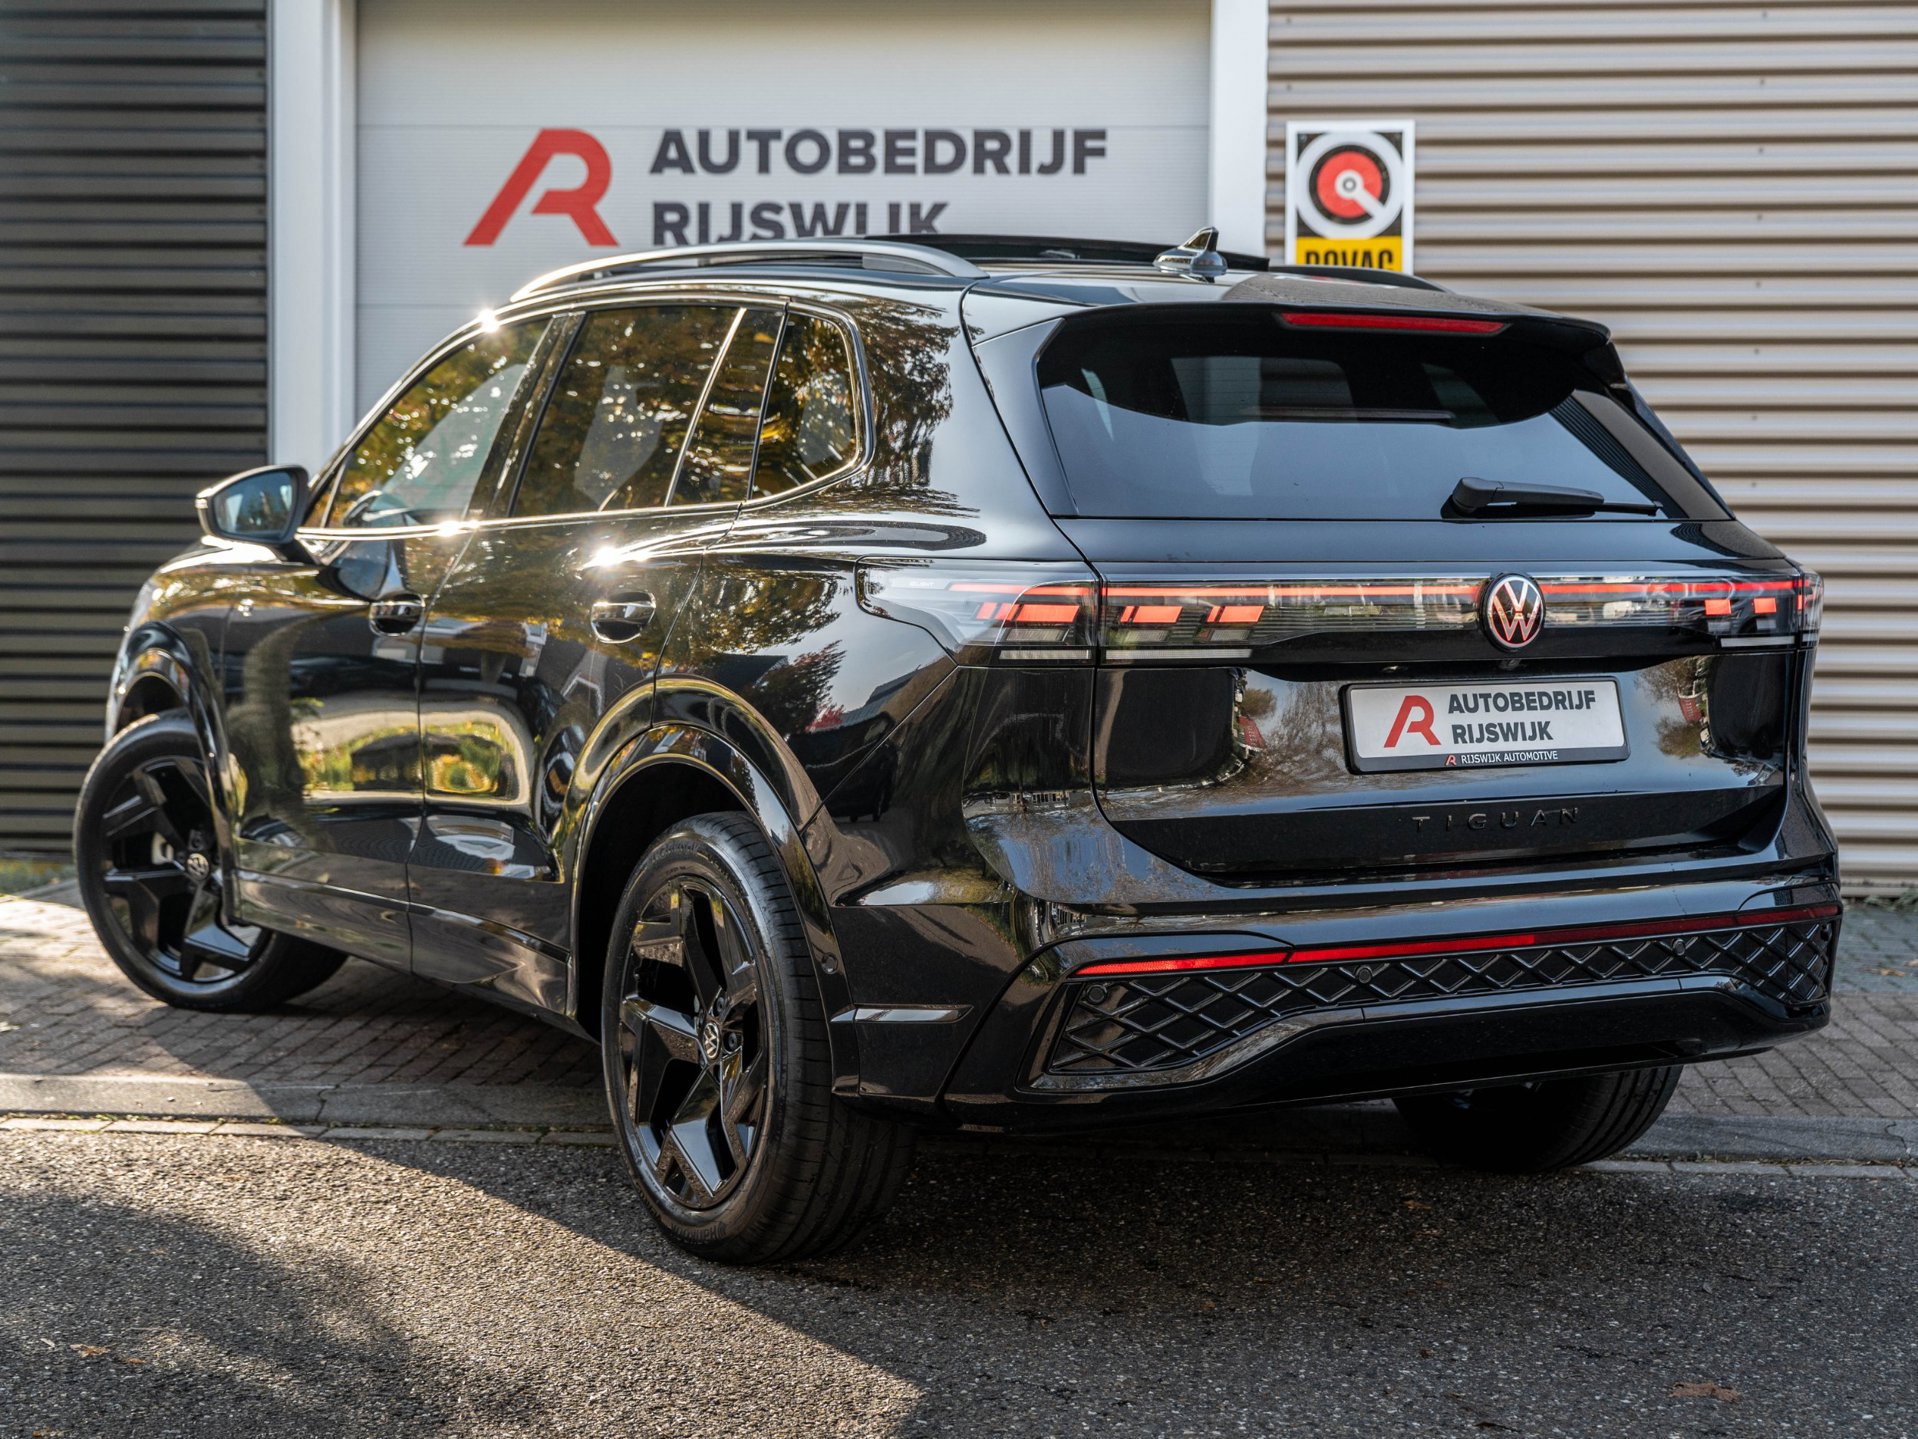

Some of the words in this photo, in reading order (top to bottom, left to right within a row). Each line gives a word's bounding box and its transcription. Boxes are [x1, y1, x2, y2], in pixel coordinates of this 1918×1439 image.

[649, 129, 1107, 175] AUTOBEDRIJF
[1448, 690, 1596, 714] AUTOBEDRIJF
[1452, 721, 1554, 745] RIJSWIJK
[1461, 753, 1502, 764] RIJSWIJK
[1503, 750, 1559, 762] AUTOMOTIVE
[1411, 807, 1579, 832] TIGUAN
